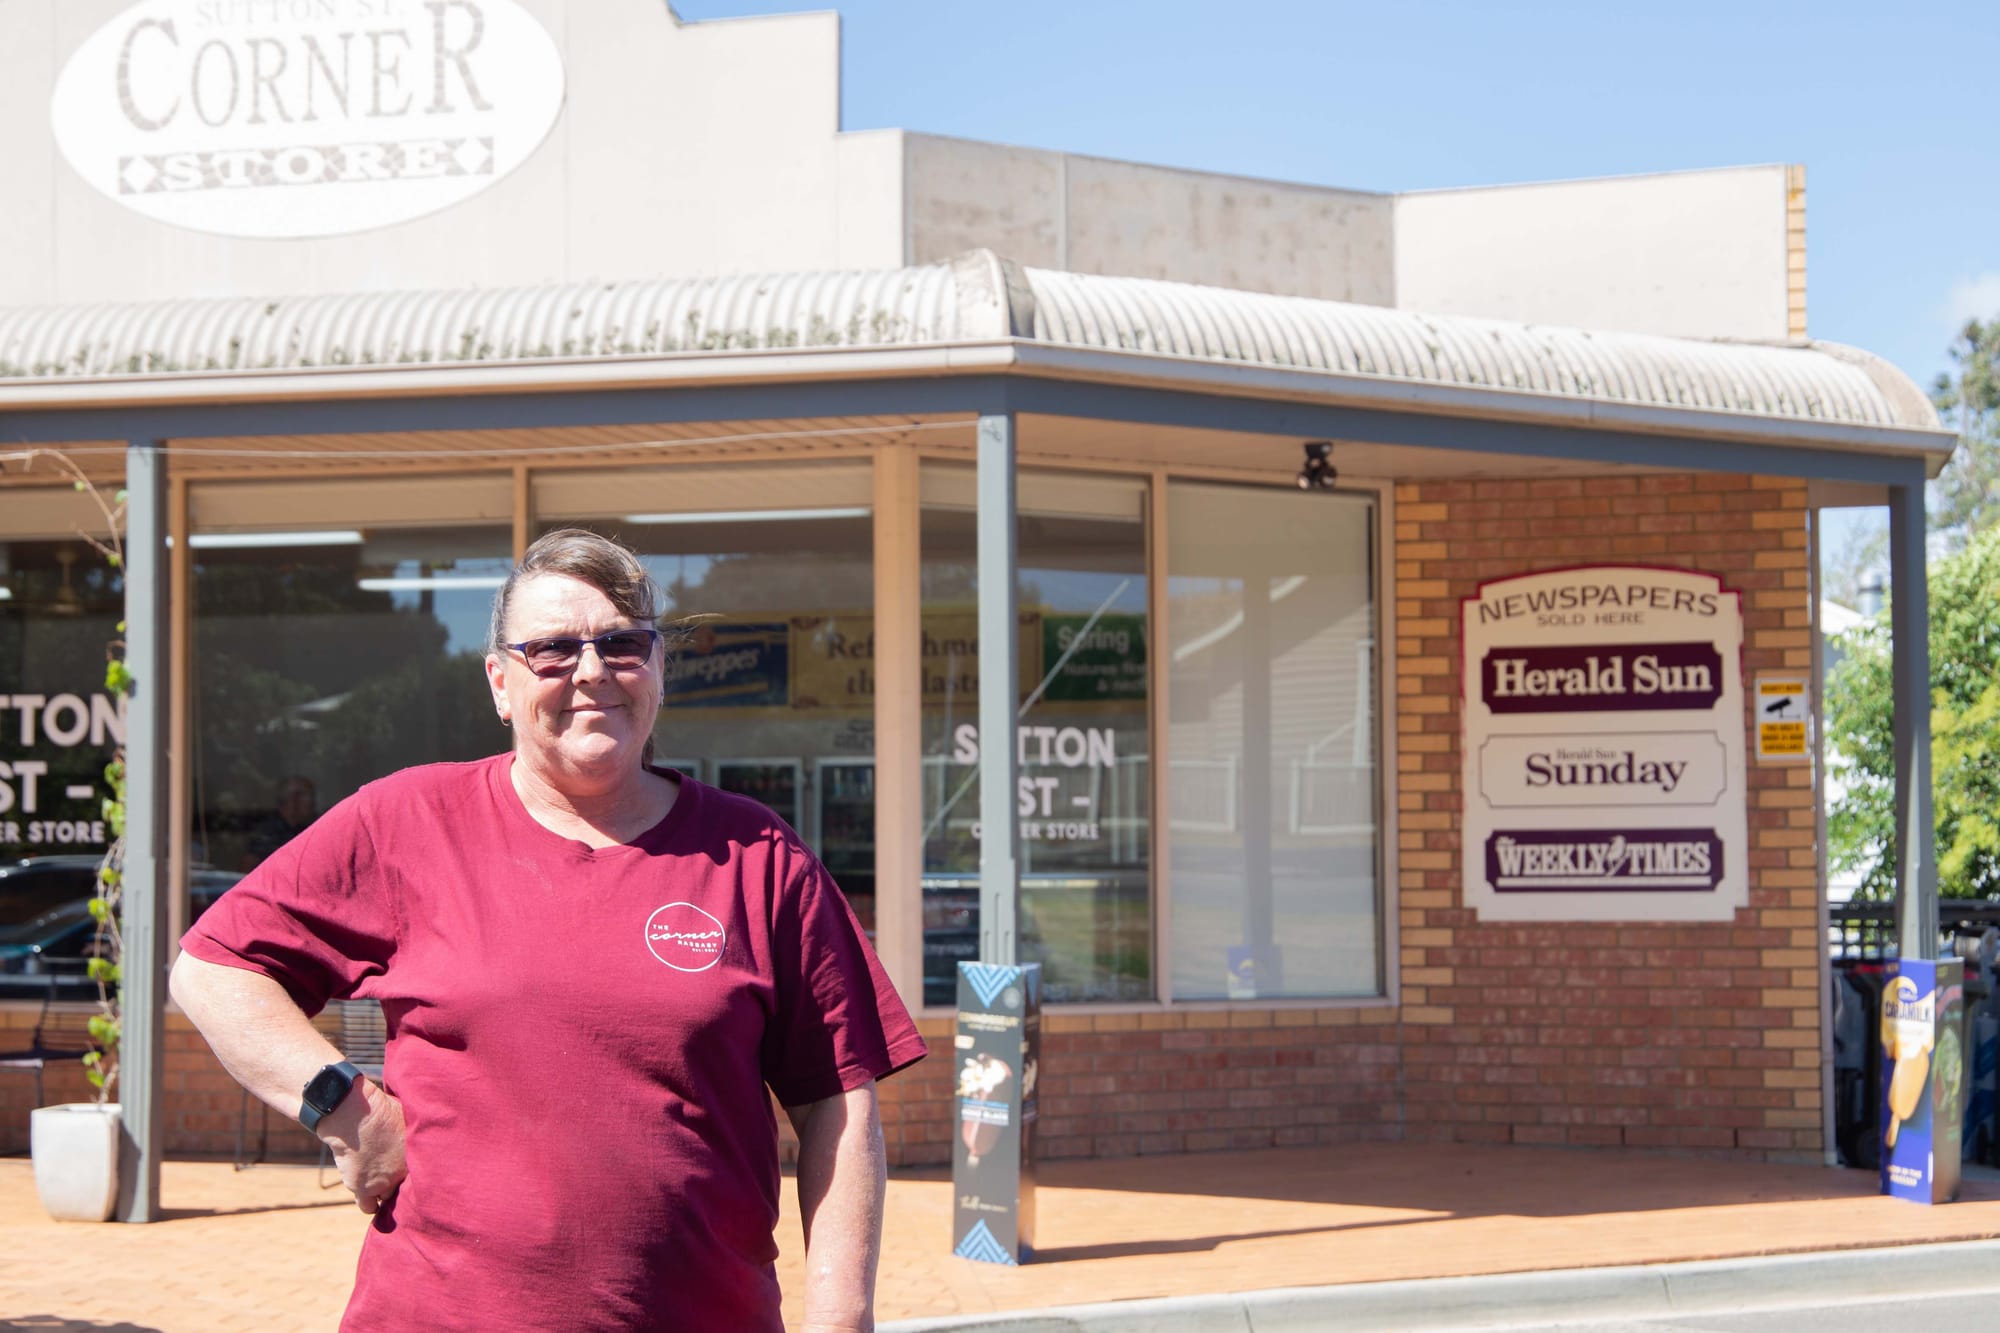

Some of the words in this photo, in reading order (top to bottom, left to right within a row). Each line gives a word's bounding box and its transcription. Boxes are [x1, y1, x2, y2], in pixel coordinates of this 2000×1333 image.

[116, 0, 494, 132] CORNER
[161, 140, 453, 190] STORE
[1479, 585, 1719, 624] NEWSPAPERS
[1537, 612, 1586, 627] SOLD
[1594, 611, 1645, 625] HERE
[1492, 655, 1625, 696] Herald
[1631, 654, 1713, 693] Sun
[953, 723, 1115, 768] STTON
[1556, 748, 1593, 760] Herald
[1595, 748, 1617, 759] Sun
[1524, 750, 1689, 793] Sunday
[28, 821, 105, 844] STORE
[970, 822, 1042, 841] CER
[1046, 822, 1100, 840] STORE
[1496, 842, 1609, 875] WEEKLY
[1627, 841, 1712, 875] TIMES
[649, 931, 722, 940] corner
